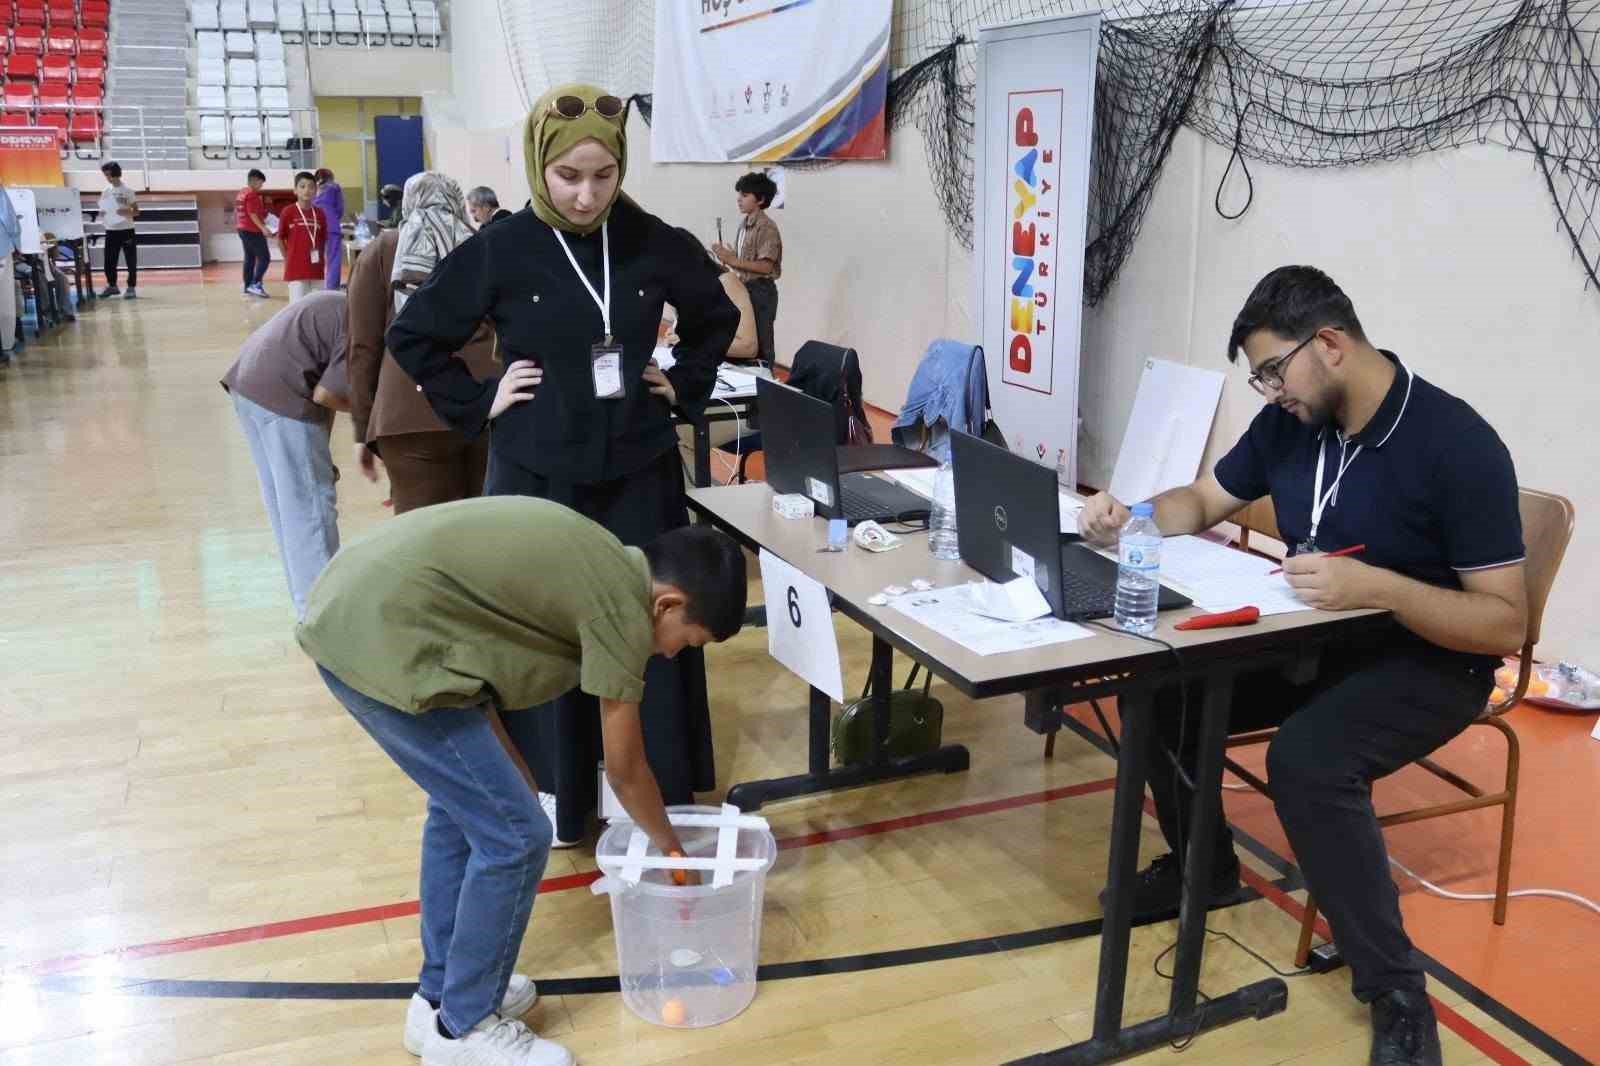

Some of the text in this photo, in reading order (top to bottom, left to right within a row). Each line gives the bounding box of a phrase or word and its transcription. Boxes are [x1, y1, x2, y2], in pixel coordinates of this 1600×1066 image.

[1009, 108, 1038, 373] DENEYAP
[1035, 149, 1053, 335] TÜRKİYE
[787, 585, 802, 628] 6
